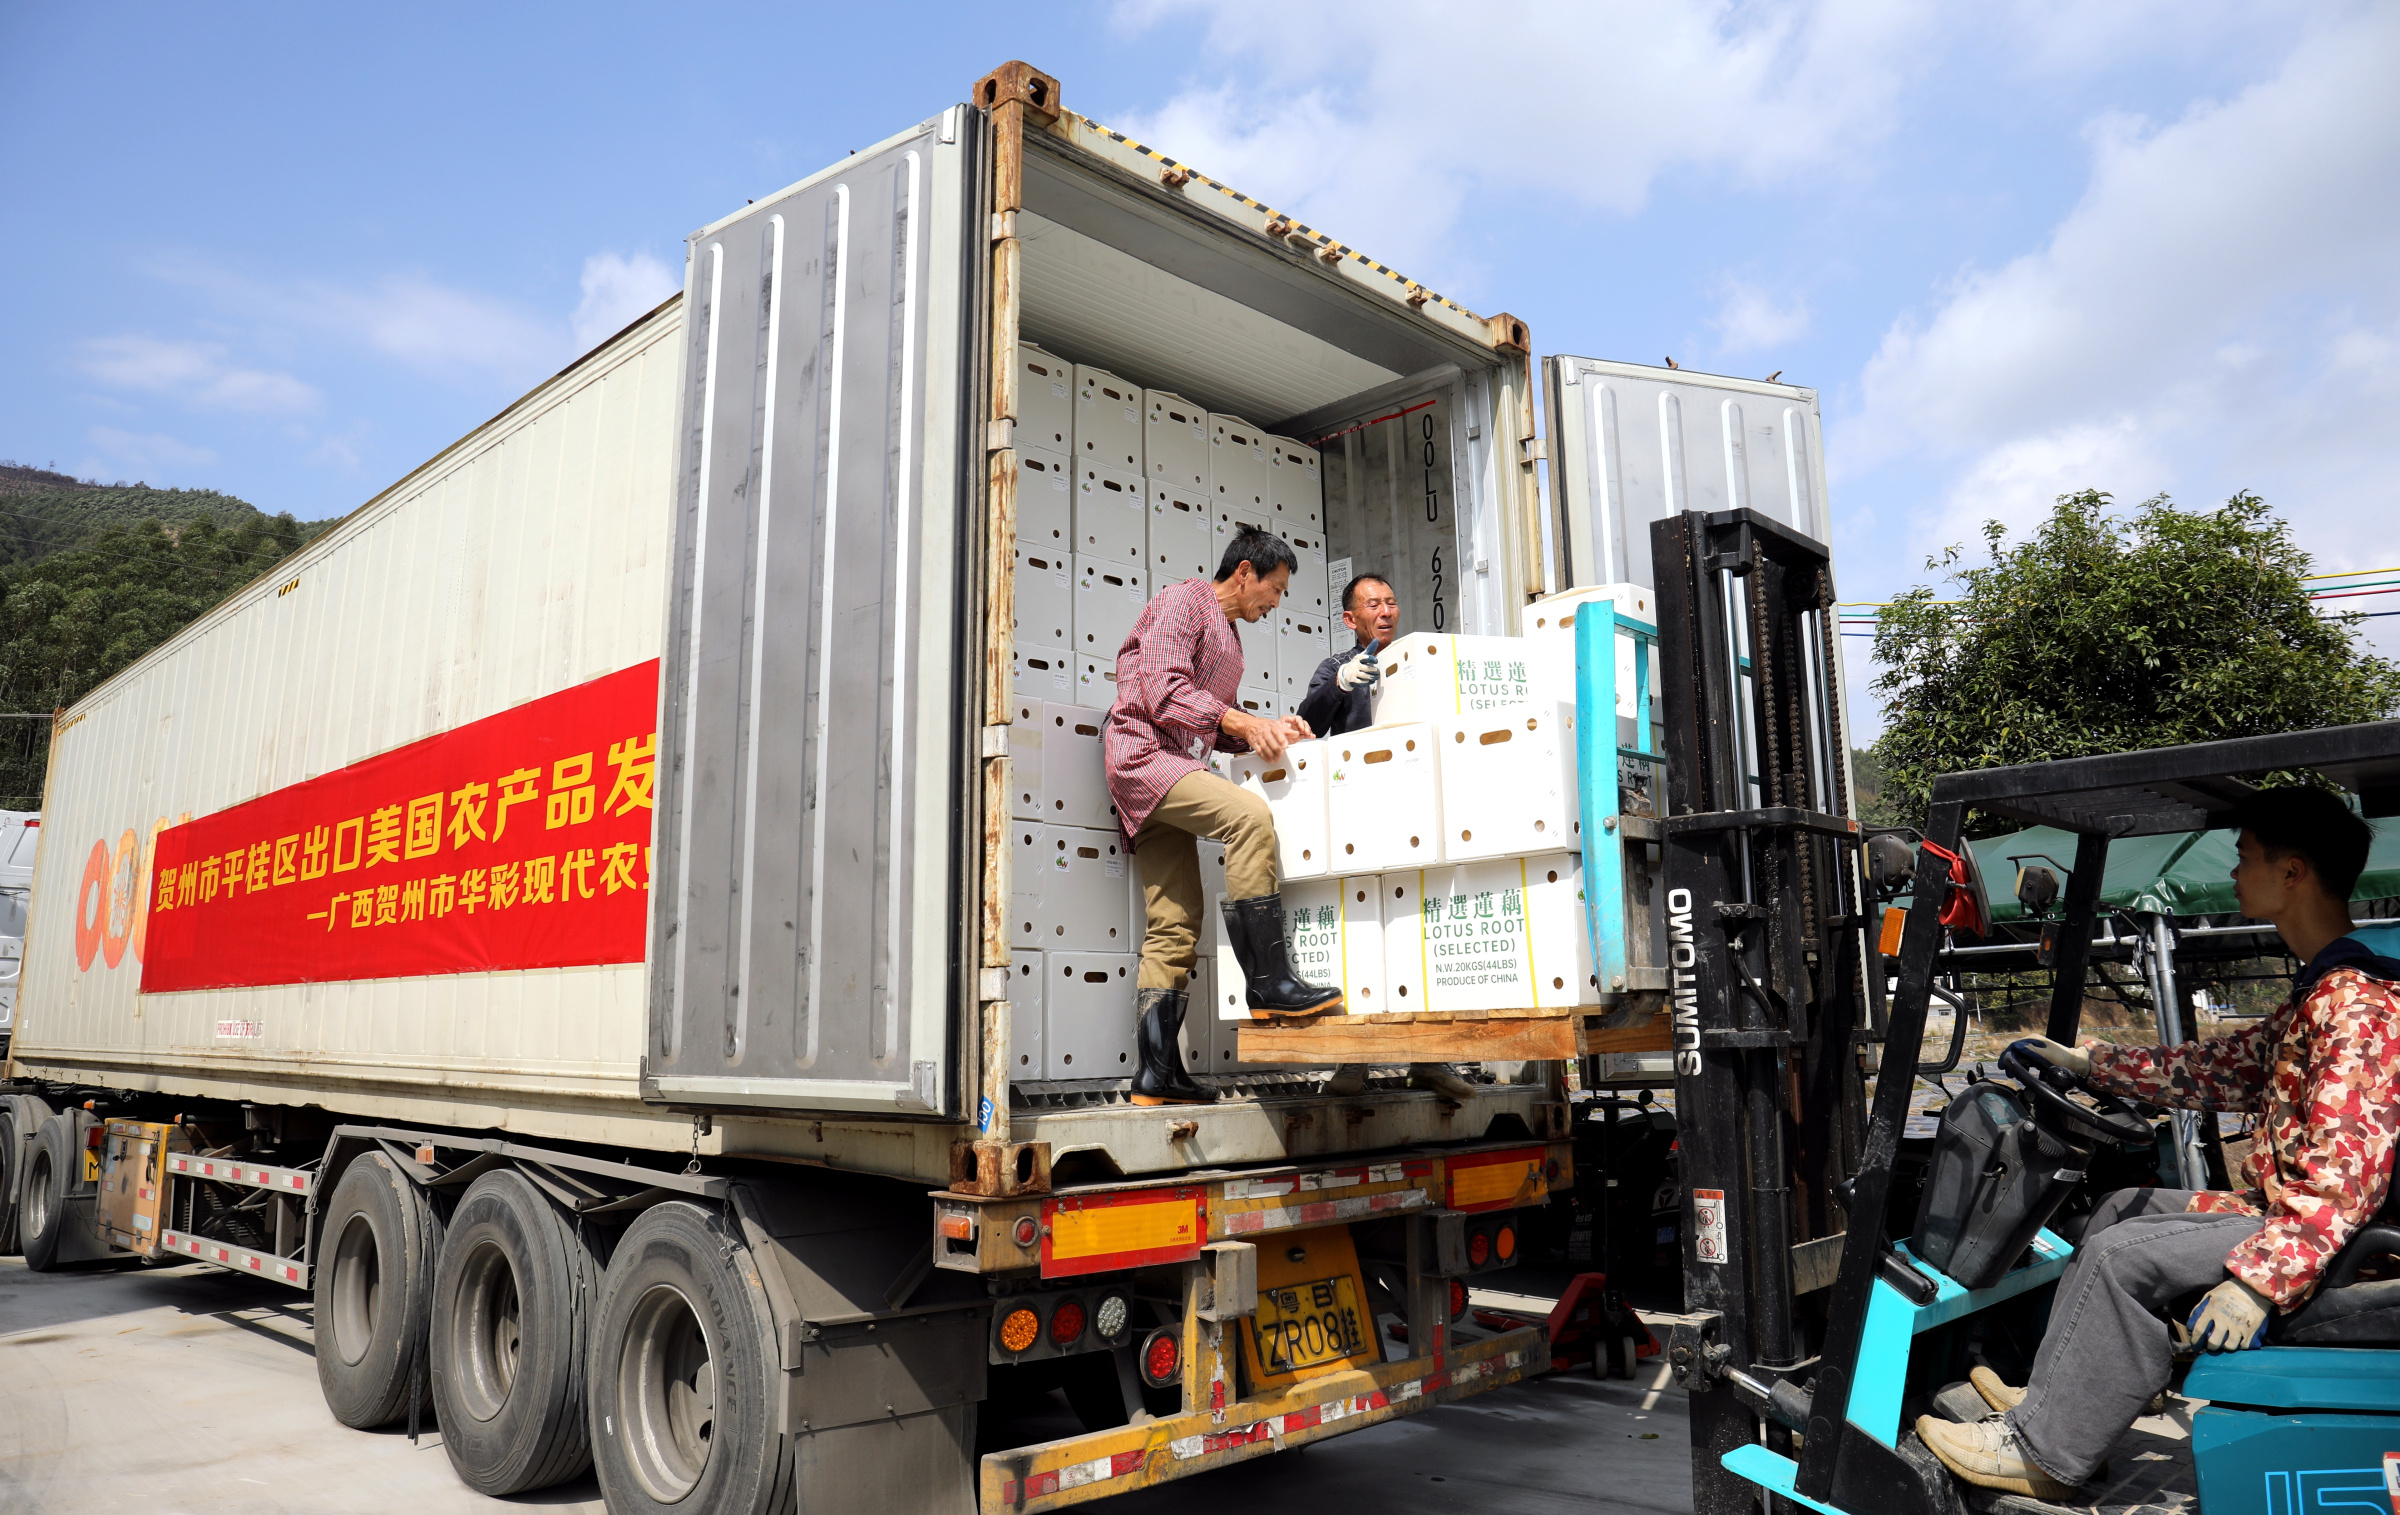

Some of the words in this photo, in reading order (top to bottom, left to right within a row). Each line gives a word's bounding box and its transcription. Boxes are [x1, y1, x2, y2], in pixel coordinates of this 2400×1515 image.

[1422, 413, 1438, 523] OOLU
[1431, 545, 1445, 633] 620
[1459, 683, 1509, 696] LOTUS
[155, 732, 657, 913] 贺州市平桂区出口美国农产品发
[1423, 888, 1522, 924] 精選蓮藕
[1423, 922, 1474, 940] LOTUS
[1480, 918, 1525, 936] ROOT
[1299, 931, 1338, 948] ROOT
[1433, 938, 1516, 958] (SELECTED)
[1287, 949, 1330, 965] CTED)
[1435, 958, 1517, 974] N.W.20KGS(44LBS)
[1436, 975, 1476, 987] PRODUCE
[1477, 974, 1489, 985] OF
[1490, 973, 1519, 984] CHINA
[1667, 887, 1703, 1077] SUMITOMO
[1177, 1224, 1189, 1235] 3M
[701, 1281, 738, 1415] ADVANCE
